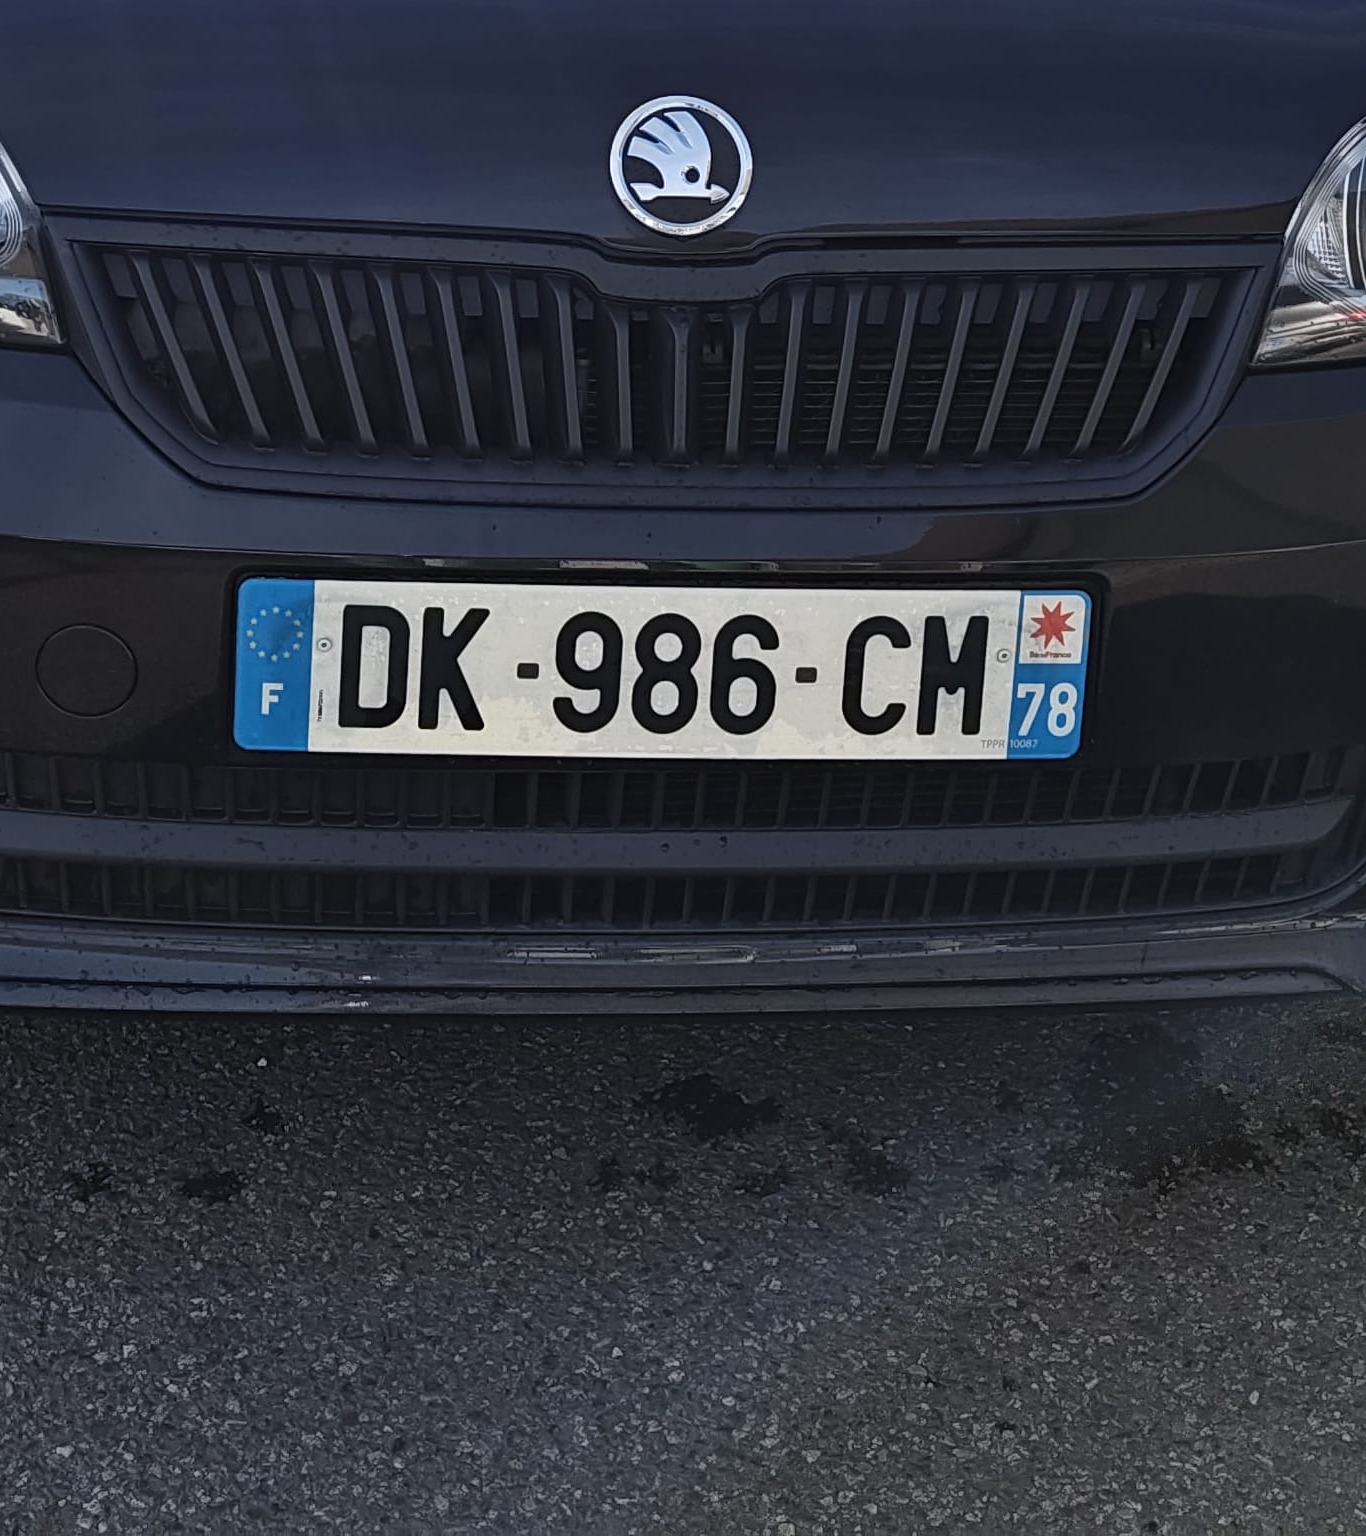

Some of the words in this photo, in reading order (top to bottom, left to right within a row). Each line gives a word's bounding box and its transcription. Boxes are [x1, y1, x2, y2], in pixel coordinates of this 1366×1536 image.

[337, 604, 990, 736] DK-986-CM
[261, 682, 284, 716] F
[1016, 682, 1078, 737] 78
